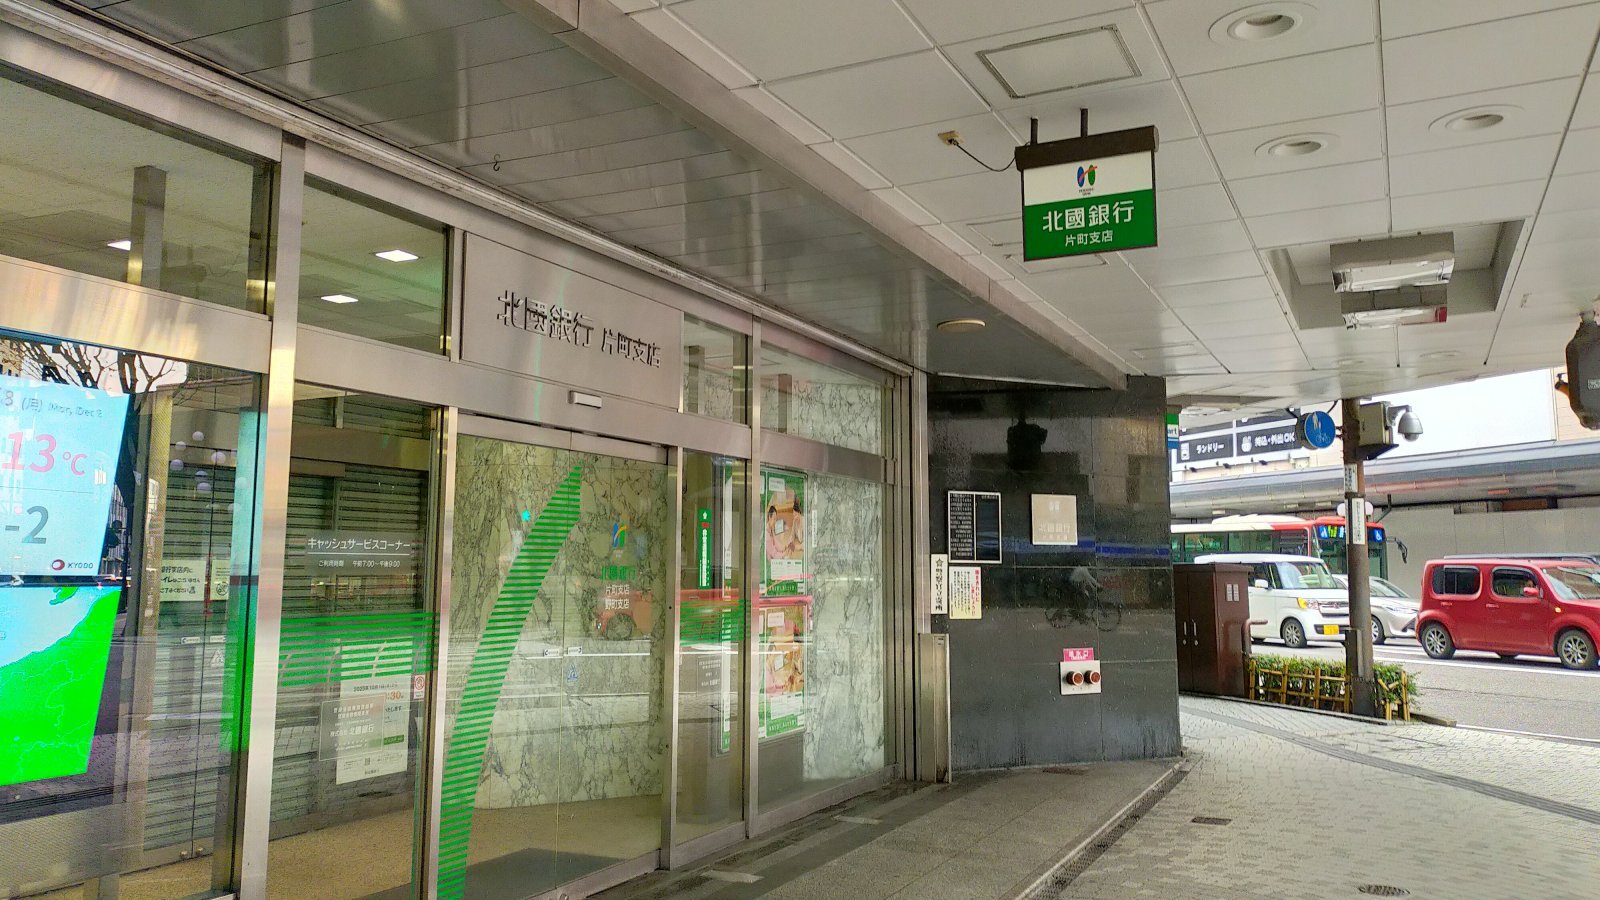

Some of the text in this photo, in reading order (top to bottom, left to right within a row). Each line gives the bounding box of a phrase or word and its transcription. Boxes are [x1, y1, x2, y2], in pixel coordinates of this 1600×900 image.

[1042, 200, 1135, 232] 北國銀行
[1065, 230, 1113, 247] 片町支店
[497, 290, 661, 368] 北國銀行 片町支店
[1196, 442, 1225, 454] ランドリー
[307, 537, 411, 550] キャッシュサービスコーナー
[605, 584, 630, 596] 片町支店
